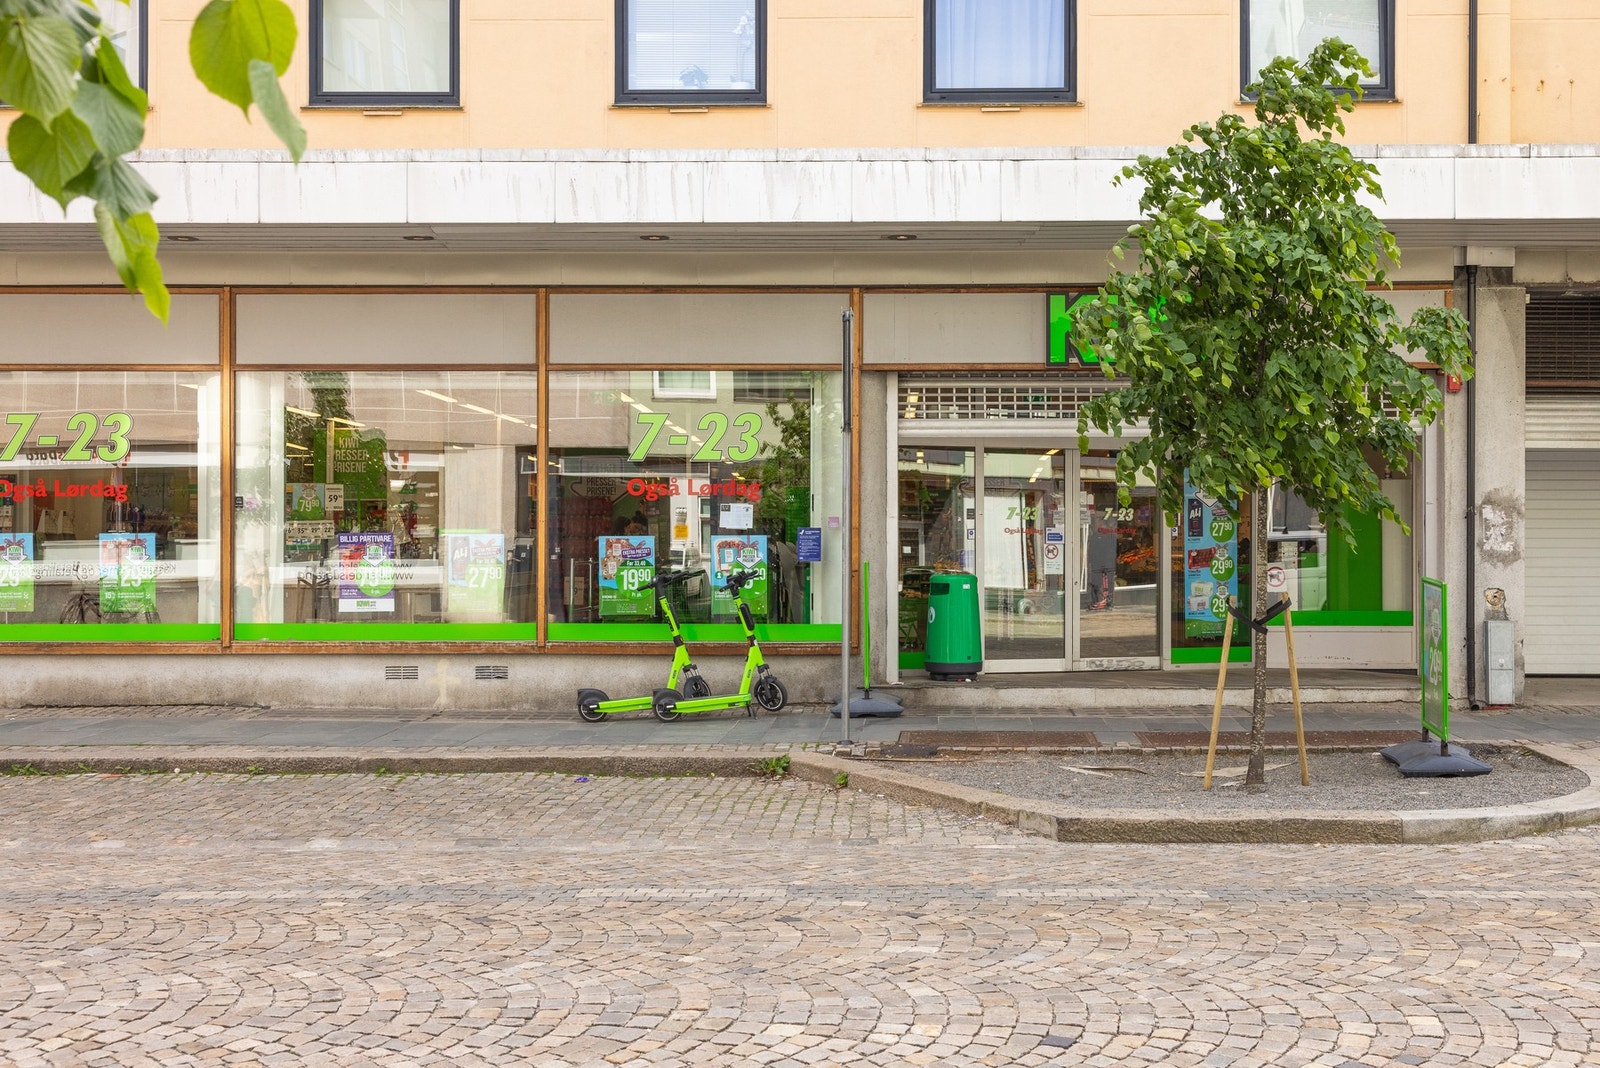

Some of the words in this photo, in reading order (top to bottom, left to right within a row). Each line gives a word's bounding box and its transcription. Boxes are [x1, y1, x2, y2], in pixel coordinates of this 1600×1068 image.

[339, 437, 360, 448] KIWI
[334, 449, 369, 461] RESSER
[0, 477, 47, 503] Også
[54, 479, 128, 503] Lørdag
[626, 476, 681, 501] Også
[687, 478, 762, 501] Lørdag
[1103, 508, 1135, 521] 7-23
[340, 535, 359, 543] BILLIG
[360, 535, 392, 543] PARTIVARE
